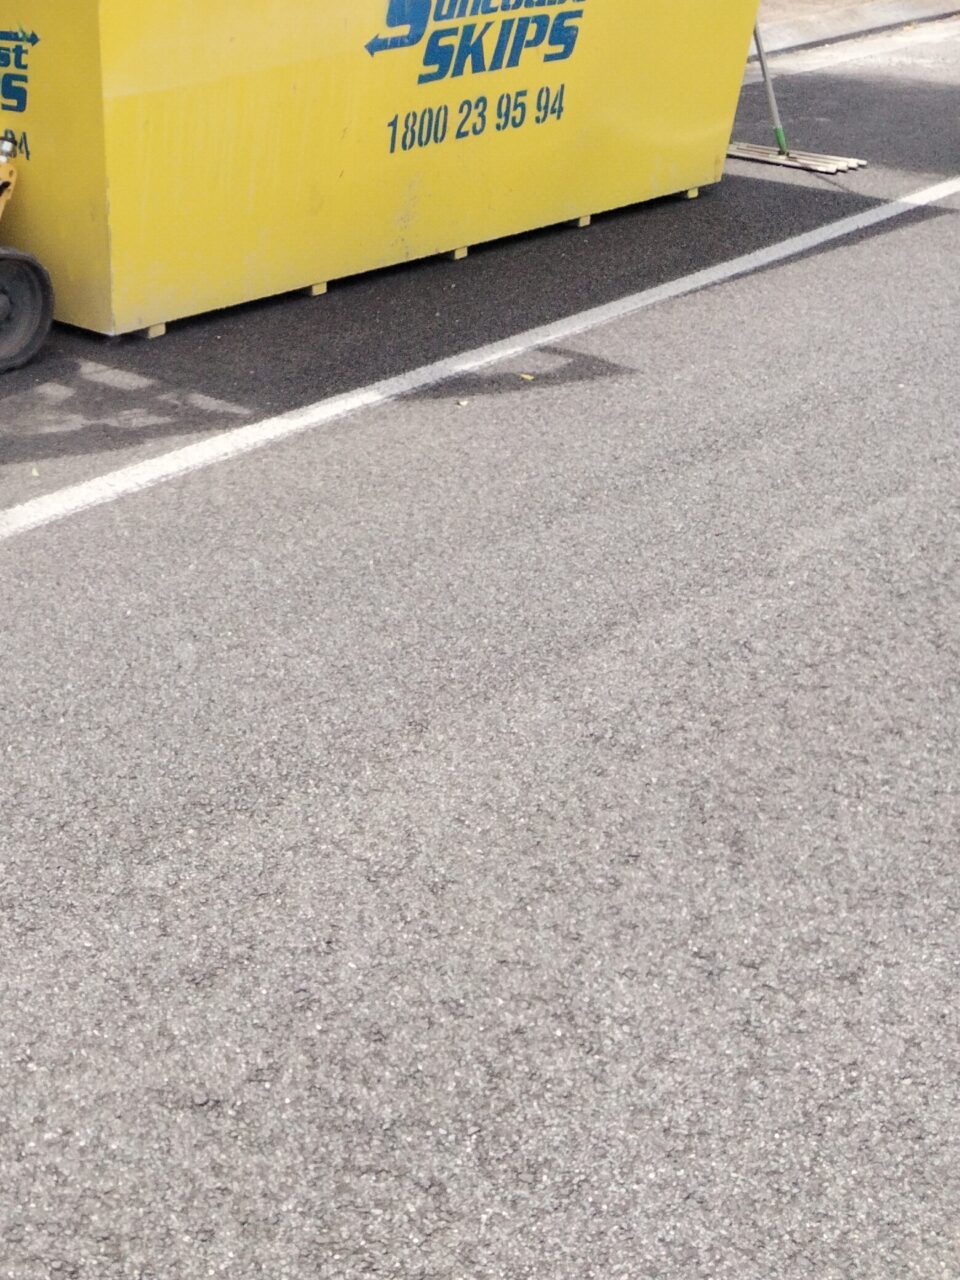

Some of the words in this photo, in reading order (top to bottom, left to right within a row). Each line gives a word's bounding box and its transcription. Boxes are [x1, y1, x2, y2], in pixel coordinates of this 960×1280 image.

[417, 9, 584, 85] SKIPS
[387, 104, 448, 154] 1800
[455, 95, 488, 140] 23
[495, 89, 528, 132] 95
[534, 83, 565, 125] 94
